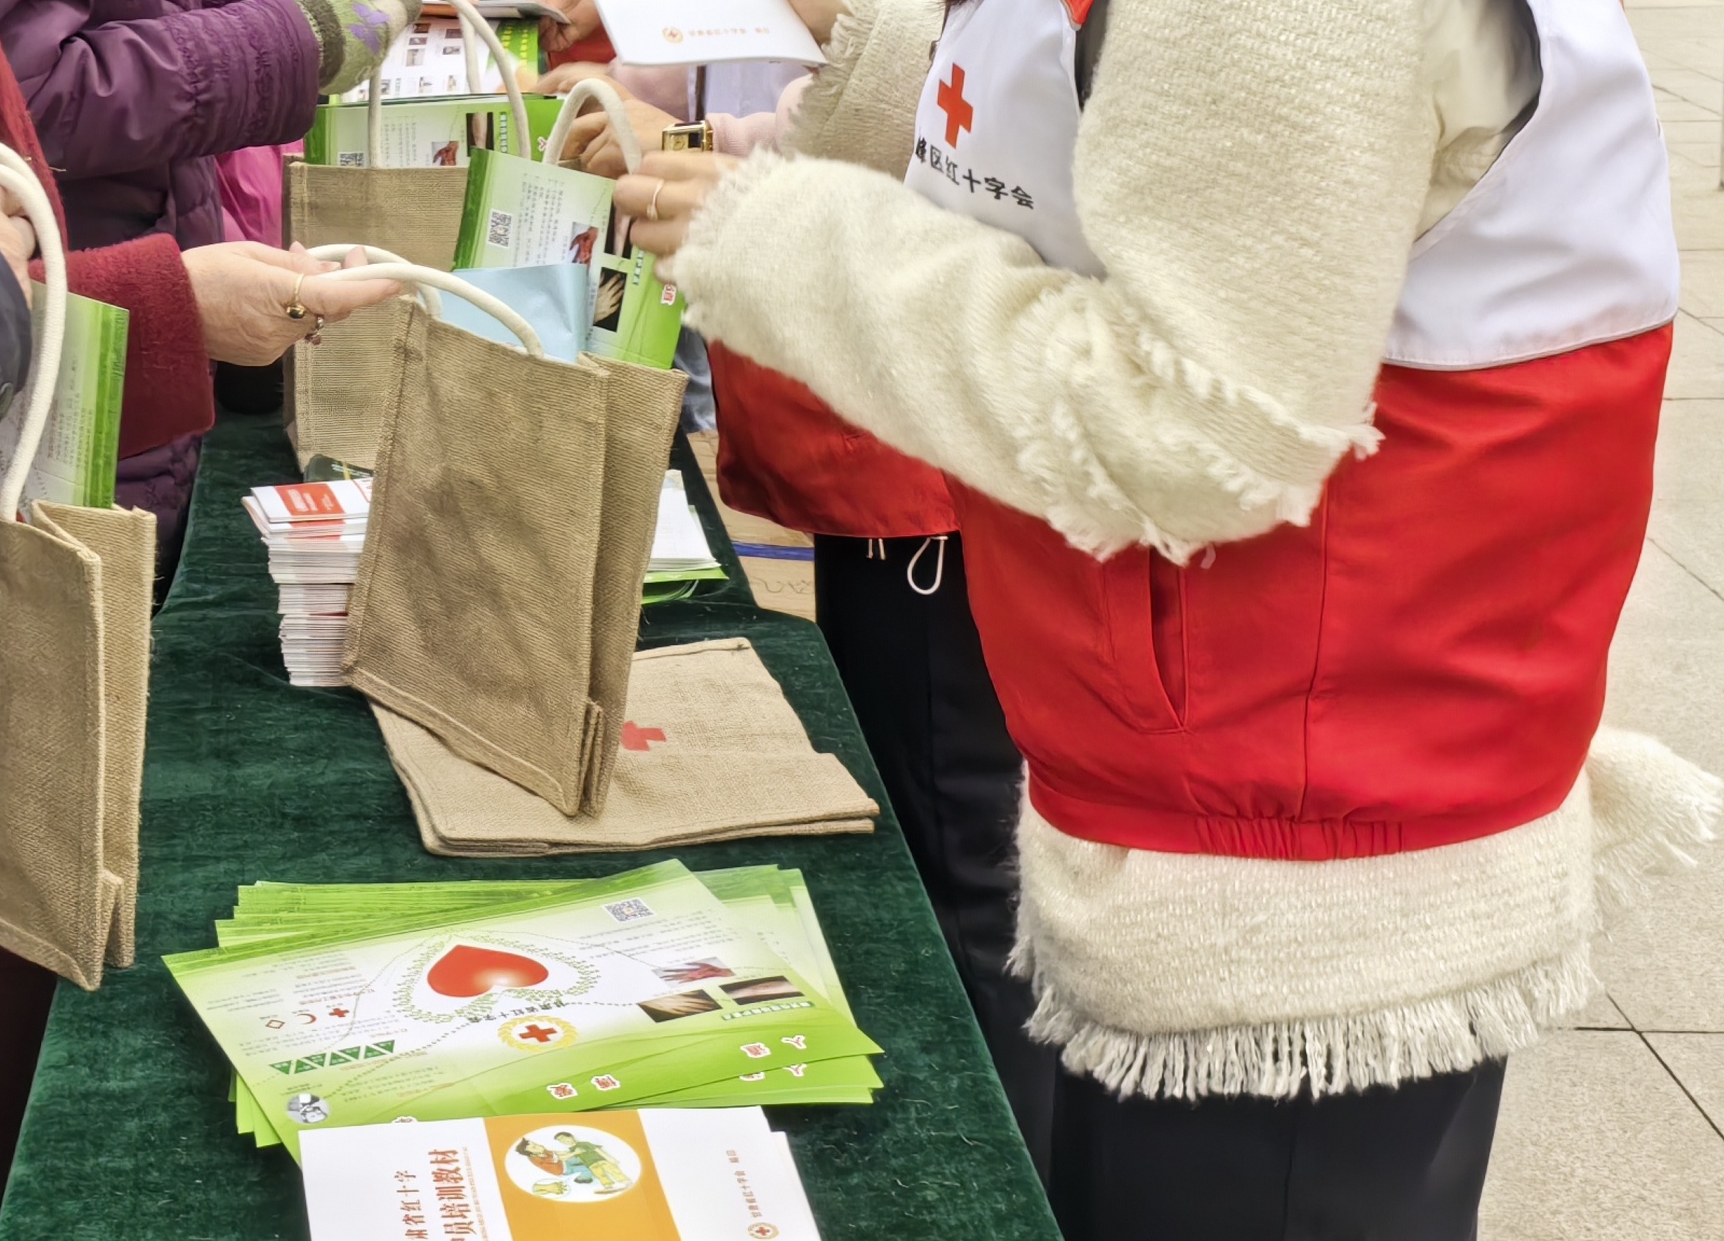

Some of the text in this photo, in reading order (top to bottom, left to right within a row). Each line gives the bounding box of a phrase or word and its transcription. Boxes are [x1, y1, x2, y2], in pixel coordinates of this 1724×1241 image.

[428, 1149, 477, 1241] 员培训教材
